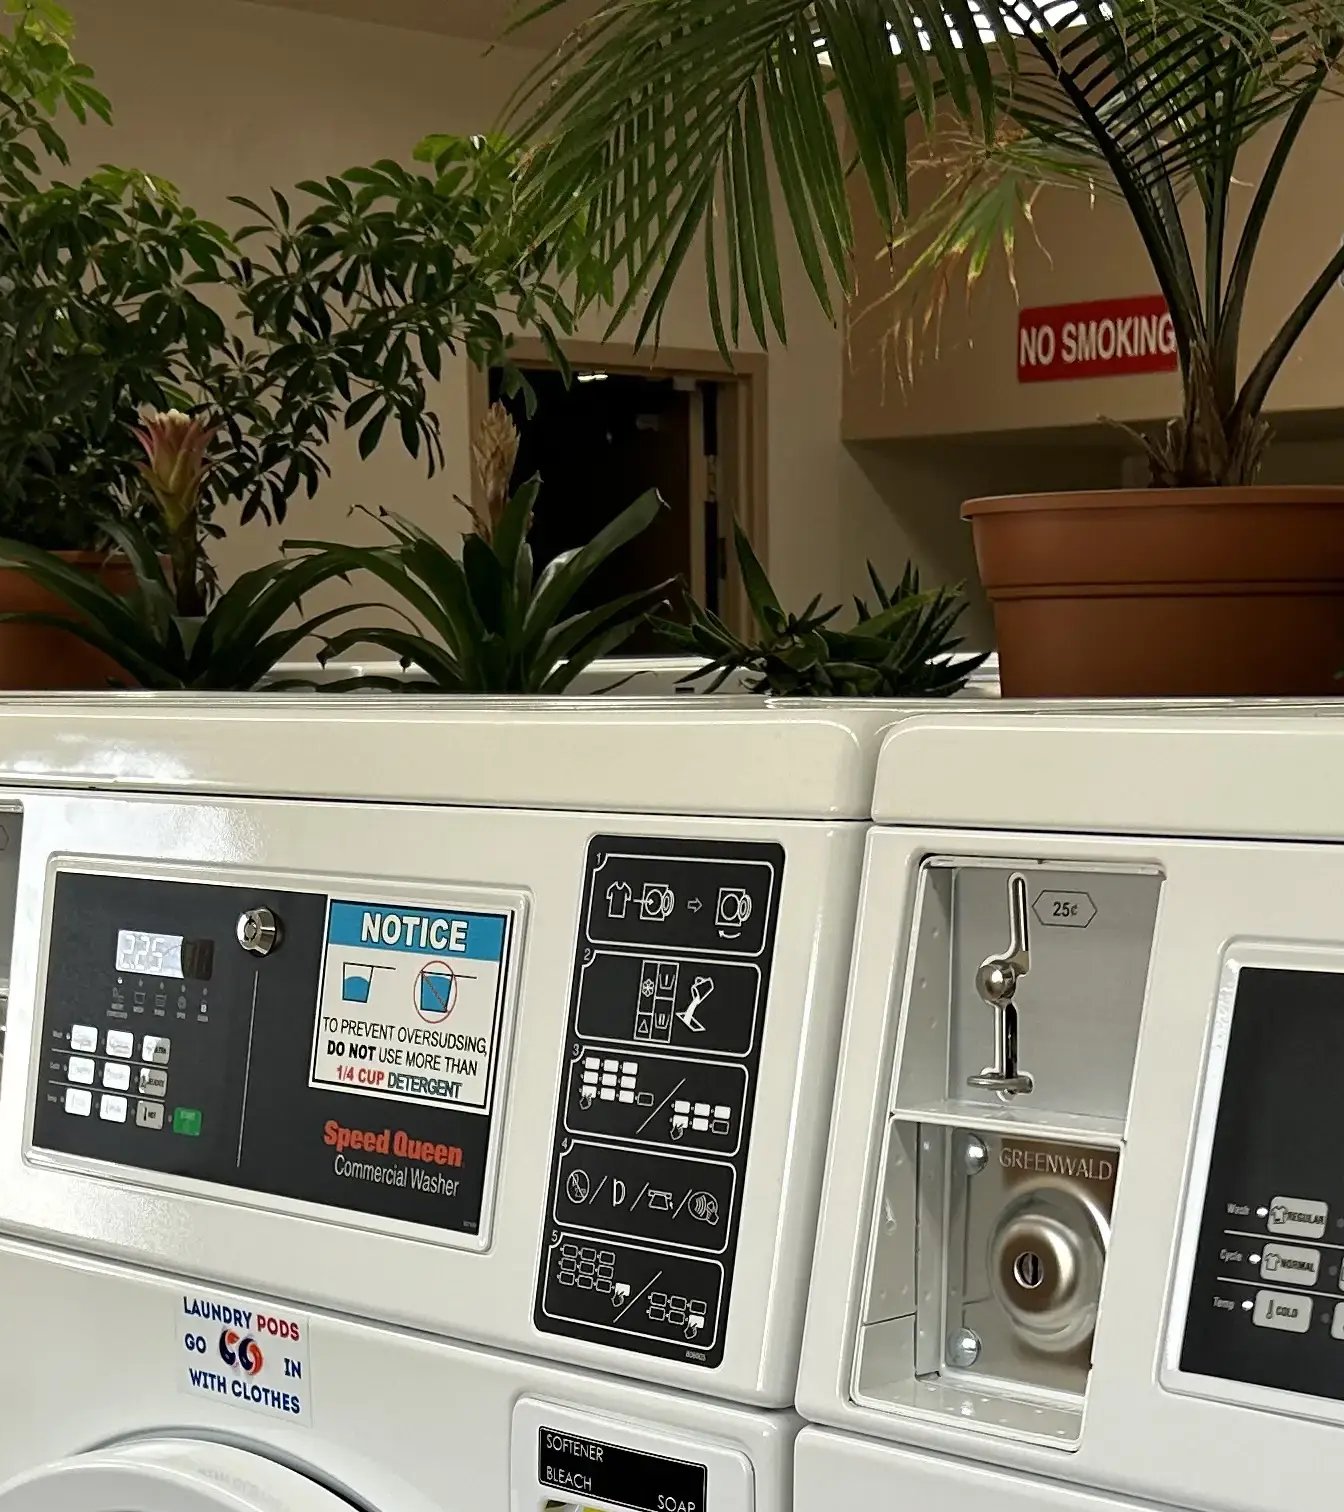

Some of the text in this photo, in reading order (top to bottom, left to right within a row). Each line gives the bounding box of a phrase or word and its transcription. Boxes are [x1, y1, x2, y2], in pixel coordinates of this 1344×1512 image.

[1020, 312, 1178, 366] NO SMOKING
[597, 853, 604, 865] 1
[1053, 901, 1078, 917] 25¢
[360, 911, 469, 952] NOTICE
[583, 949, 592, 961] 2
[323, 1016, 488, 1057] TO PREVENT OVERSUDSING,
[572, 1044, 581, 1057] 3
[327, 1039, 478, 1077] DO NOT USE MORE THAN
[336, 1064, 463, 1099] 1/4 CUP DETERGENT
[323, 1119, 463, 1168] Speed Queen
[559, 1138, 569, 1150] 4
[334, 1154, 460, 1197] Commercial Washer
[999, 1147, 1113, 1180] GREENWALD
[551, 1230, 559, 1243] 5
[183, 1296, 300, 1342] LAUNDRY PODS
[1275, 1305, 1299, 1319] COLD
[184, 1333, 302, 1379] GO IN
[189, 1367, 301, 1414] WITH CLOTHES
[545, 1433, 604, 1463] SOFTENER
[545, 1465, 592, 1491] BLEACH
